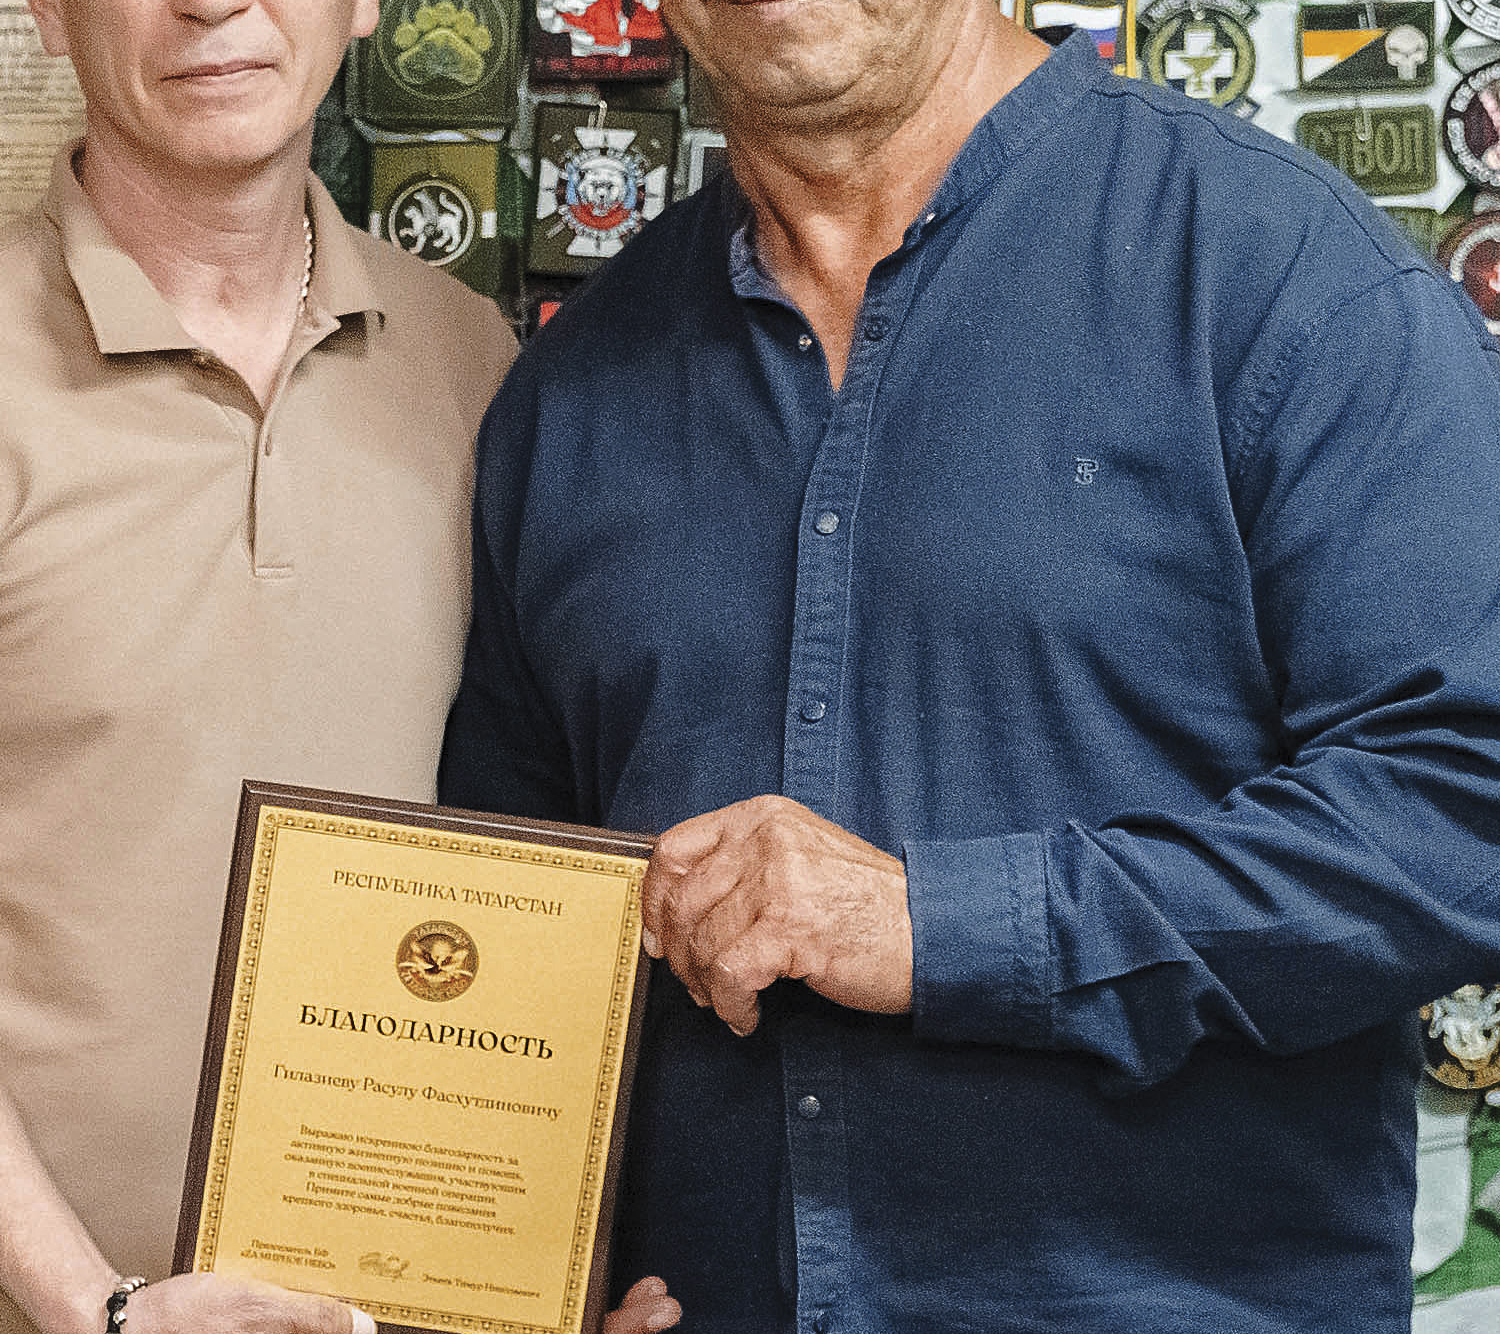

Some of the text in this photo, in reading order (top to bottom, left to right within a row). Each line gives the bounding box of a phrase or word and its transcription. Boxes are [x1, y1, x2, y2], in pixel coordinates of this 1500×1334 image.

[333, 870, 564, 917] РЕСПУБЛИКА ТАТАРСТАН
[299, 1004, 553, 1060] БЛАГОДАРНОСТЬ
[273, 1063, 358, 1092] Гилазиеву
[363, 1077, 418, 1101] Расулу
[290, 1139, 345, 1156] активную
[348, 1147, 414, 1165] жизненную
[300, 1124, 353, 1142] Выражаю
[355, 1133, 422, 1152] искреннюю
[424, 1142, 505, 1165] благодарность
[284, 1151, 345, 1169] оказанную
[449, 1173, 527, 1195] участвующим
[317, 1171, 390, 1189] специальной
[392, 1180, 438, 1197] военной
[282, 1193, 333, 1211] крепкого
[389, 1208, 434, 1225] счастья,
[306, 1181, 496, 1218] Примите самые добрые пожелания
